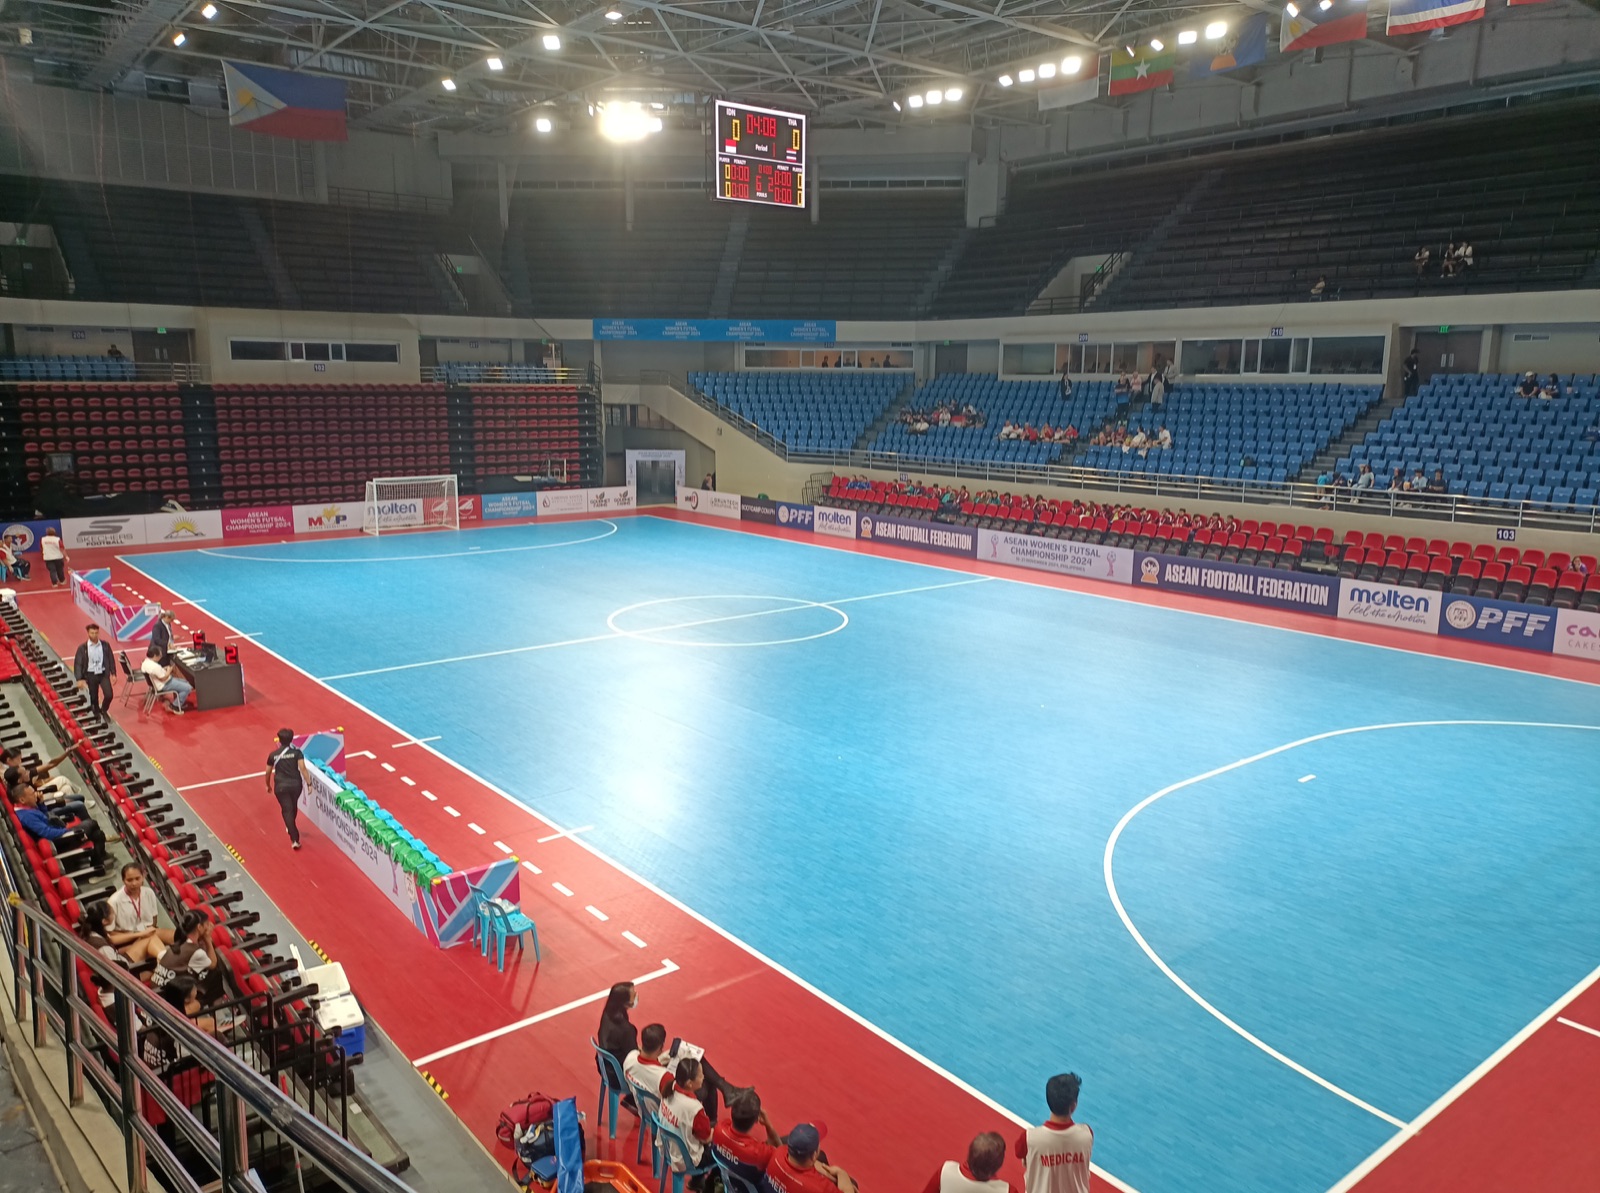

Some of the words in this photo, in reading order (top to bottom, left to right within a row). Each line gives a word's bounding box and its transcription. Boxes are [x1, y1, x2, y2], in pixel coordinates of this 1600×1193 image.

[726, 108, 736, 116] IDN
[732, 119, 740, 141] 0
[746, 113, 776, 137] 04:08
[787, 118, 798, 126] THA
[755, 144, 768, 152] Period
[792, 129, 800, 150] 0
[725, 164, 731, 179] 0
[725, 181, 731, 198] 0
[789, 508, 813, 525] PFF
[818, 511, 852, 526] molten
[226, 523, 273, 531] CHAMPIONSHIP
[875, 522, 896, 538] ASEAN
[897, 524, 929, 544] FOOTBALL
[930, 529, 972, 550] FEDERATION
[1497, 529, 1515, 540] 103
[76, 534, 133, 543] SKECHERS
[1004, 536, 1028, 548] ASEAN
[1030, 540, 1068, 552] WOMEN'S
[1069, 545, 1100, 558] FUTSAL
[1010, 546, 1069, 562] CHAMPIONSHIP
[1070, 556, 1092, 567] 2024
[1165, 563, 1200, 586] ASEAN
[1201, 568, 1254, 595] FOOTBALL
[1256, 576, 1330, 606] FEDERATION
[1350, 588, 1430, 612] molten
[1476, 607, 1551, 636] PFF
[226, 646, 237, 664] 2
[316, 796, 360, 844] CHAMPIONSHIP
[360, 838, 378, 864] 2024
[716, 1144, 739, 1165] MEDIC
[1040, 1152, 1084, 1168] MEDICAL
